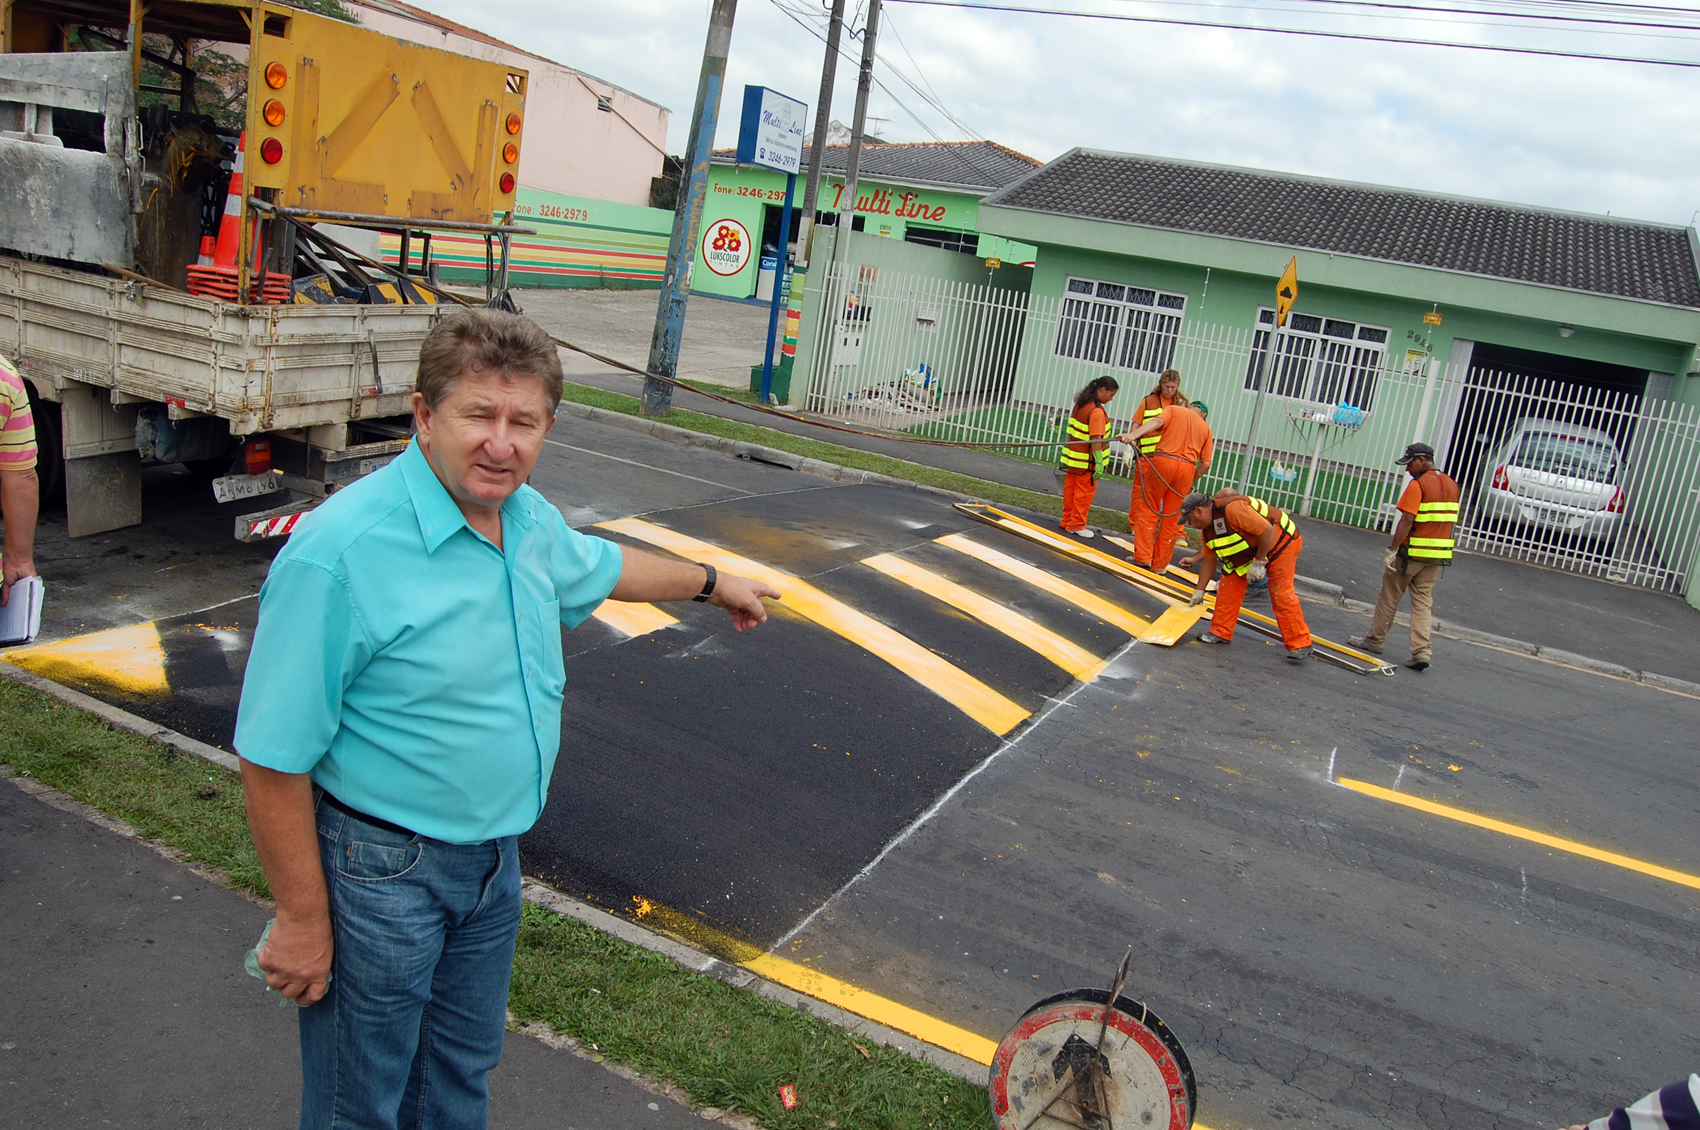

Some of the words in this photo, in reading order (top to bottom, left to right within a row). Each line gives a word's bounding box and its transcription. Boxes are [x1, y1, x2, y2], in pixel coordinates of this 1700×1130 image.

[763, 110, 782, 130] Multi
[789, 121, 803, 137] Line
[767, 151, 797, 168] 3246-2979
[713, 182, 735, 195] Fone:
[737, 186, 787, 202] 3246-297
[539, 204, 588, 222] 3246-2979
[894, 190, 946, 222] Line
[710, 250, 741, 264] LUKSCOLOR
[1406, 329, 1434, 353] 2946
